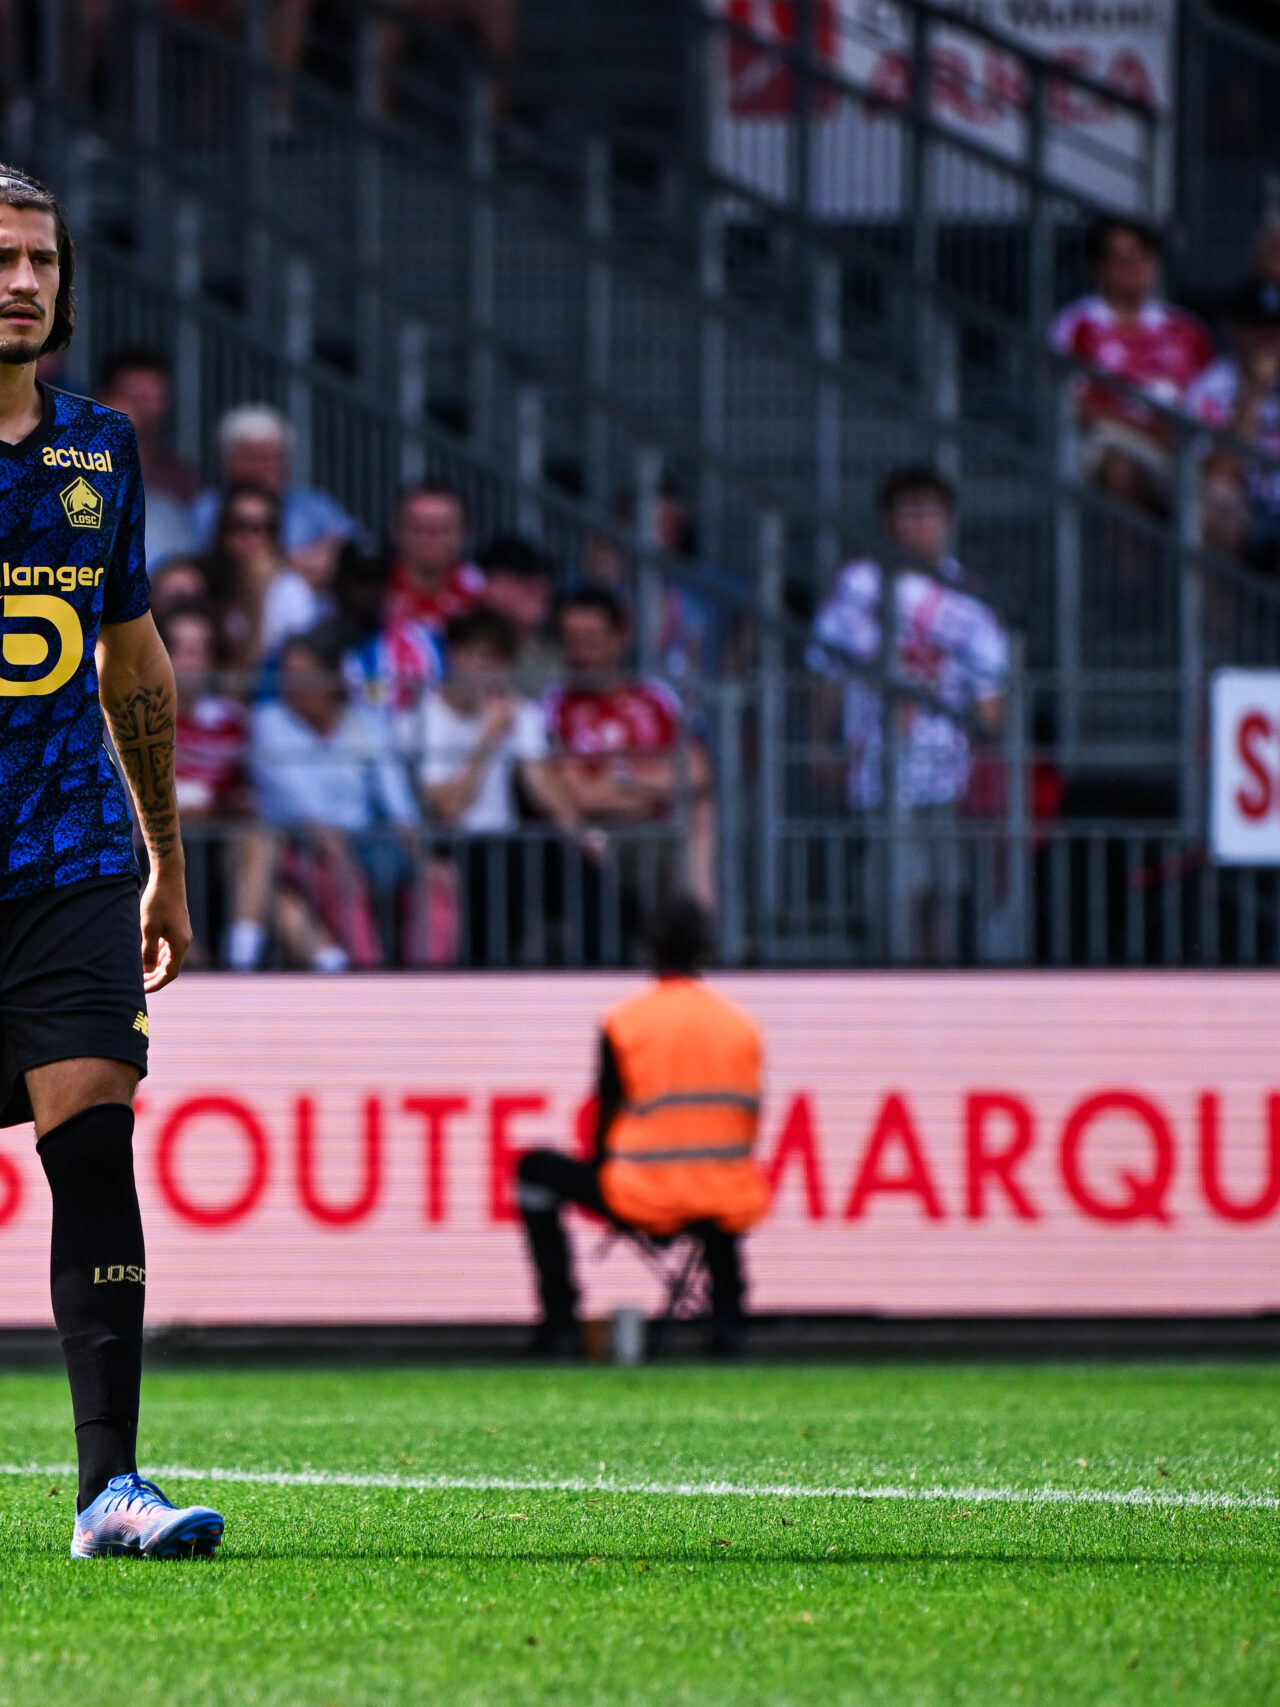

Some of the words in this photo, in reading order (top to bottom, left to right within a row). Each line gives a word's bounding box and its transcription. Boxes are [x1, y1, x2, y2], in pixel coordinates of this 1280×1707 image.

[41, 446, 113, 472] actual
[73, 514, 97, 525] LOSC
[130, 1090, 600, 1232] OUTE
